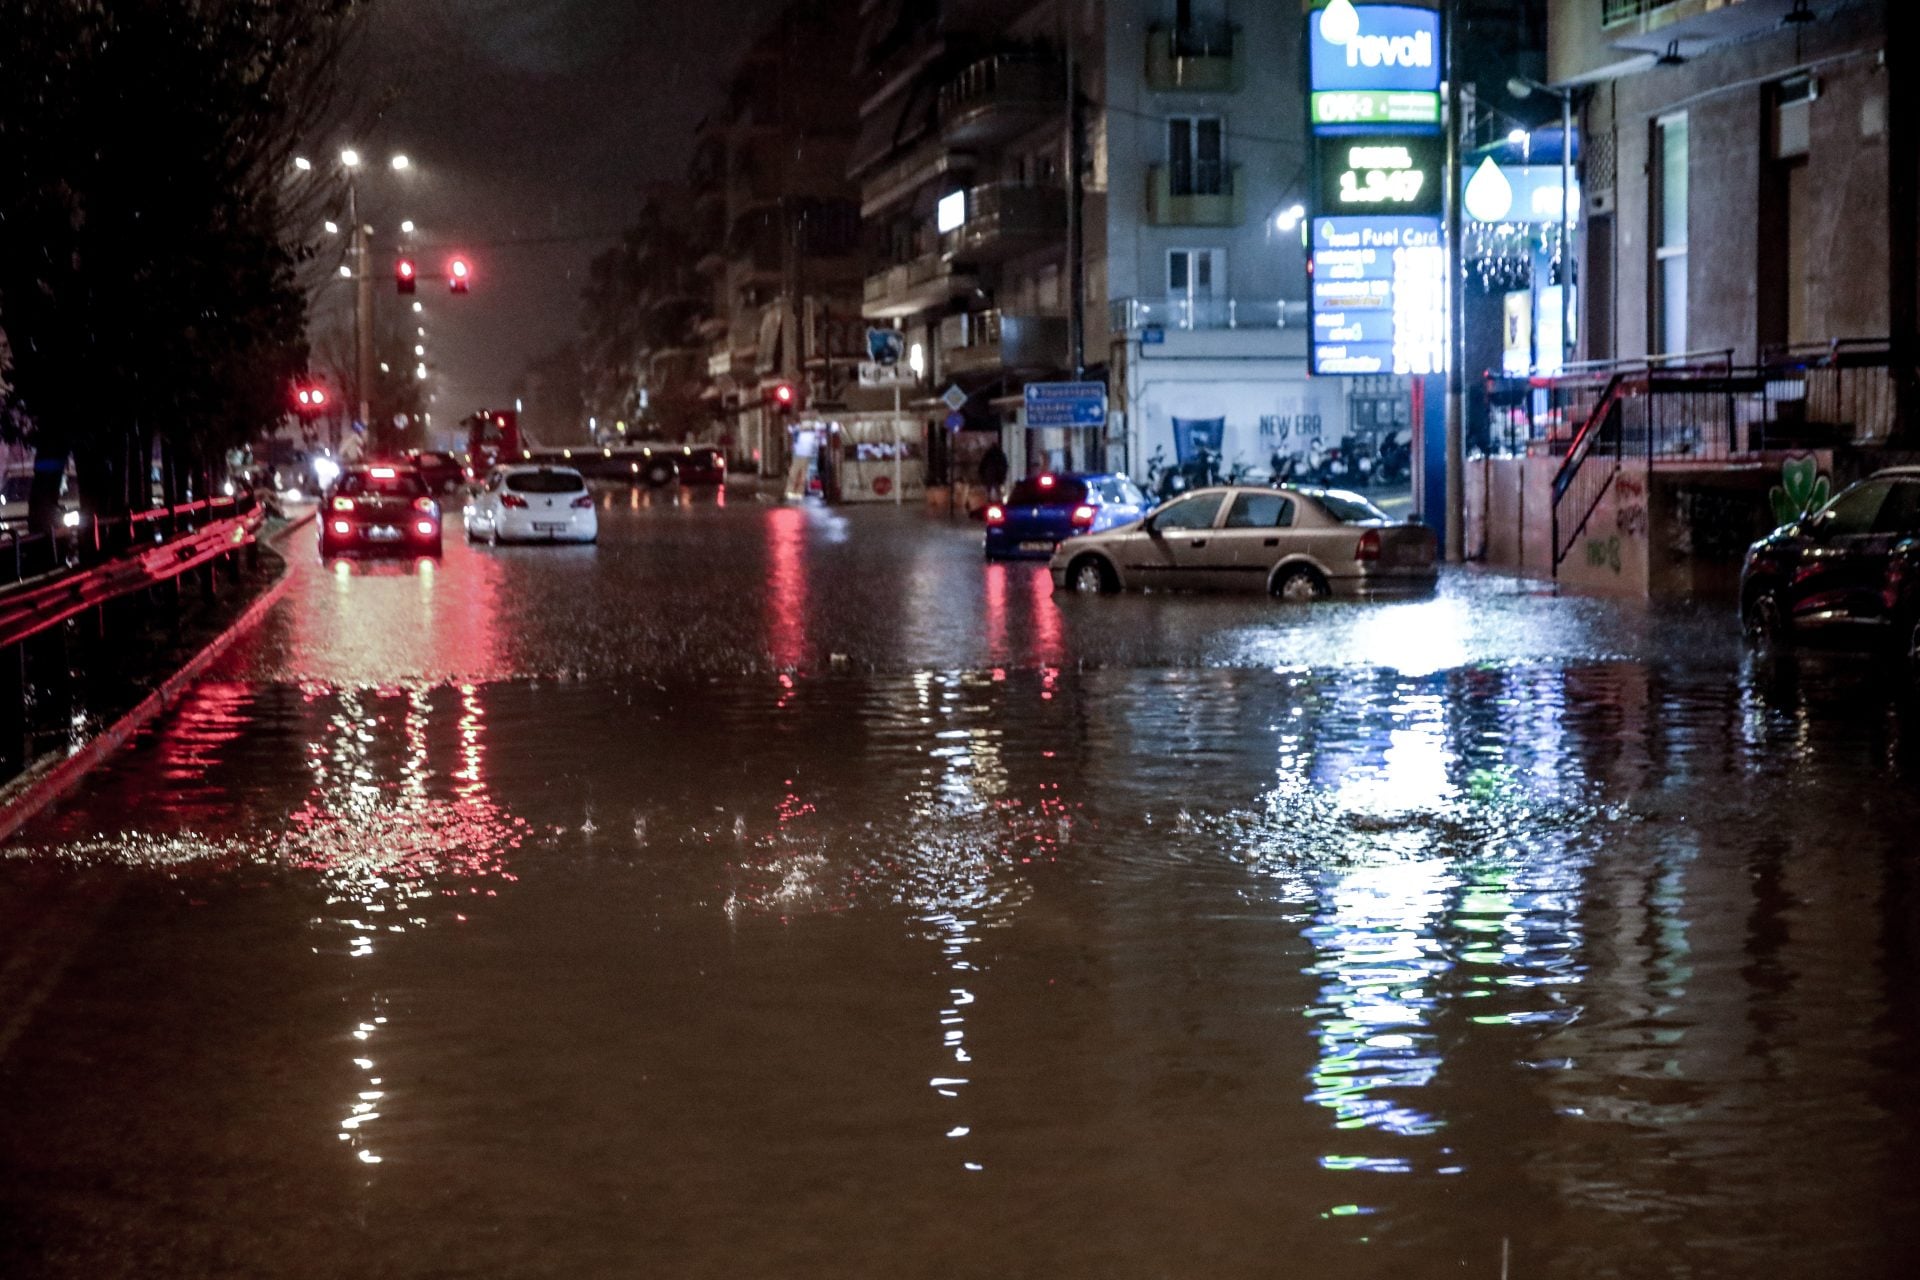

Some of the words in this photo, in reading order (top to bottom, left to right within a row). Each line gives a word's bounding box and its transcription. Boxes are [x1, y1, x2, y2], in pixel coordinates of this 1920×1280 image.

[1362, 228, 1398, 246] Fuel
[1403, 227, 1438, 246] Card
[1260, 415, 1291, 437] NEW
[1296, 414, 1322, 435] ERA
